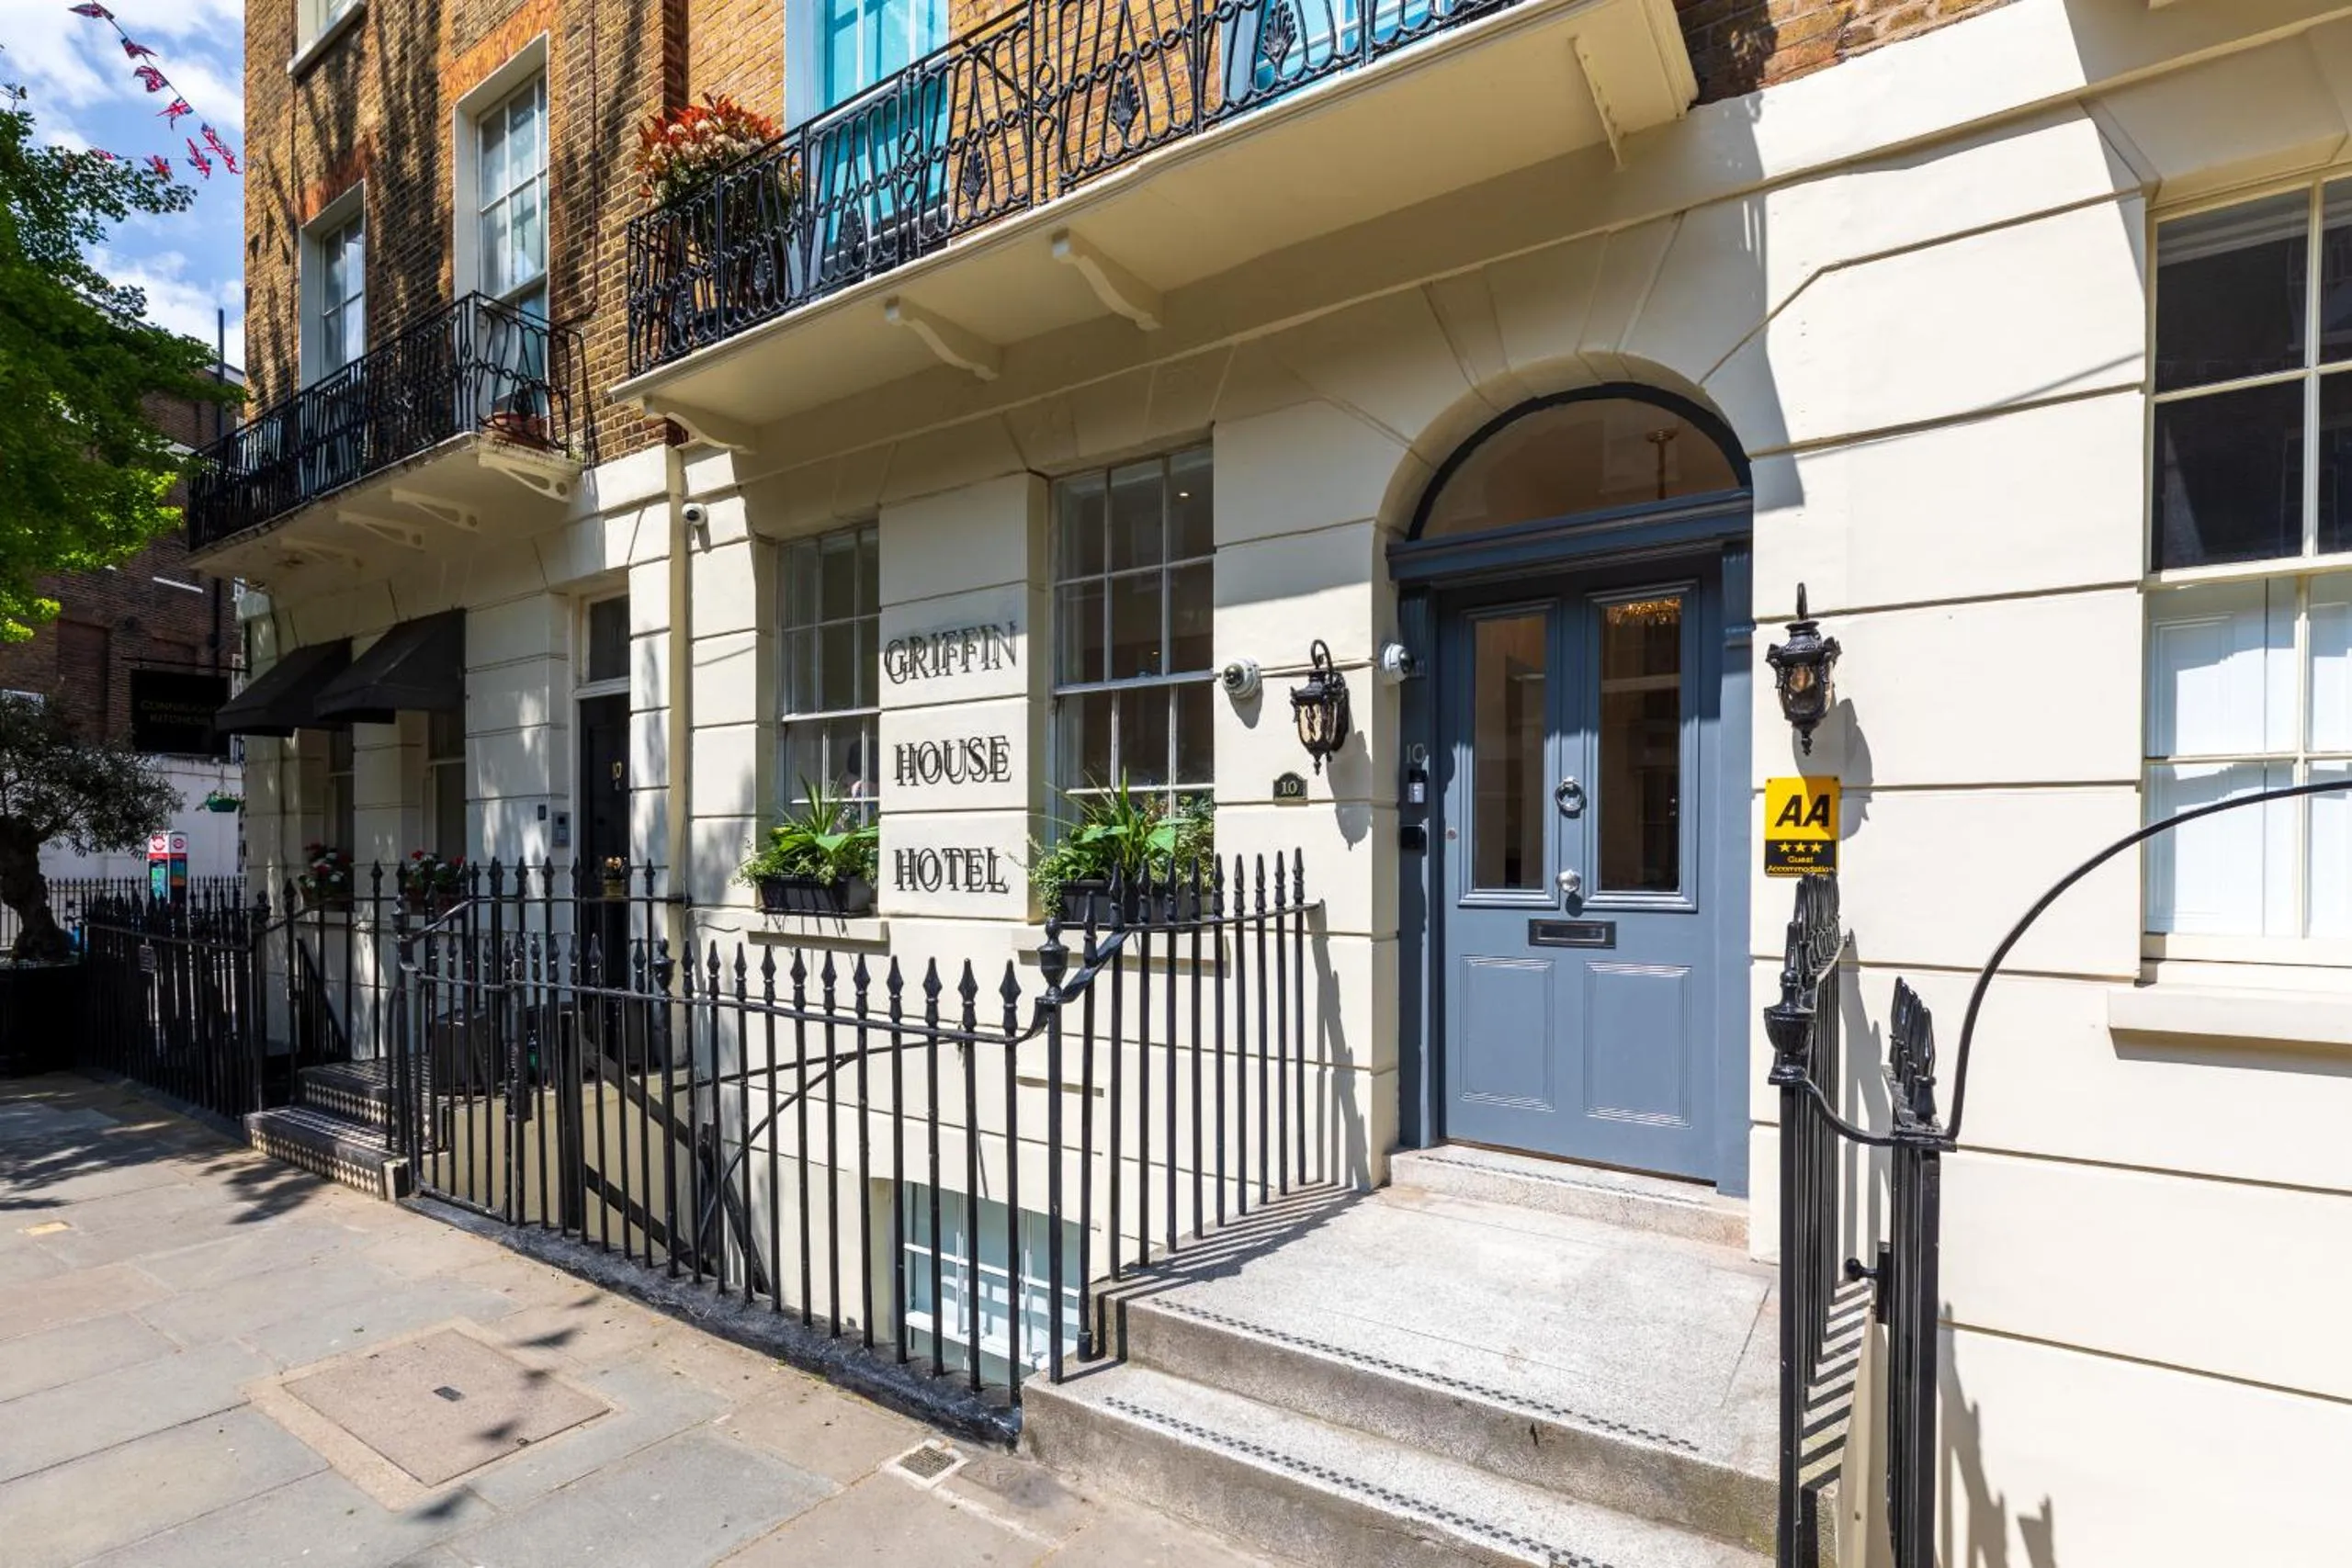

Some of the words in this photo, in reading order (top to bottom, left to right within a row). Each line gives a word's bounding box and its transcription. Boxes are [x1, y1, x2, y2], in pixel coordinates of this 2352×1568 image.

[884, 620, 1017, 684] GRIFFIN
[893, 735, 1012, 786] HOUSE
[1406, 743, 1426, 763] 10
[1281, 781, 1297, 795] 10
[1774, 794, 1831, 828] AA
[893, 846, 1009, 895] HOTEL
[1787, 855, 1814, 863] Guest
